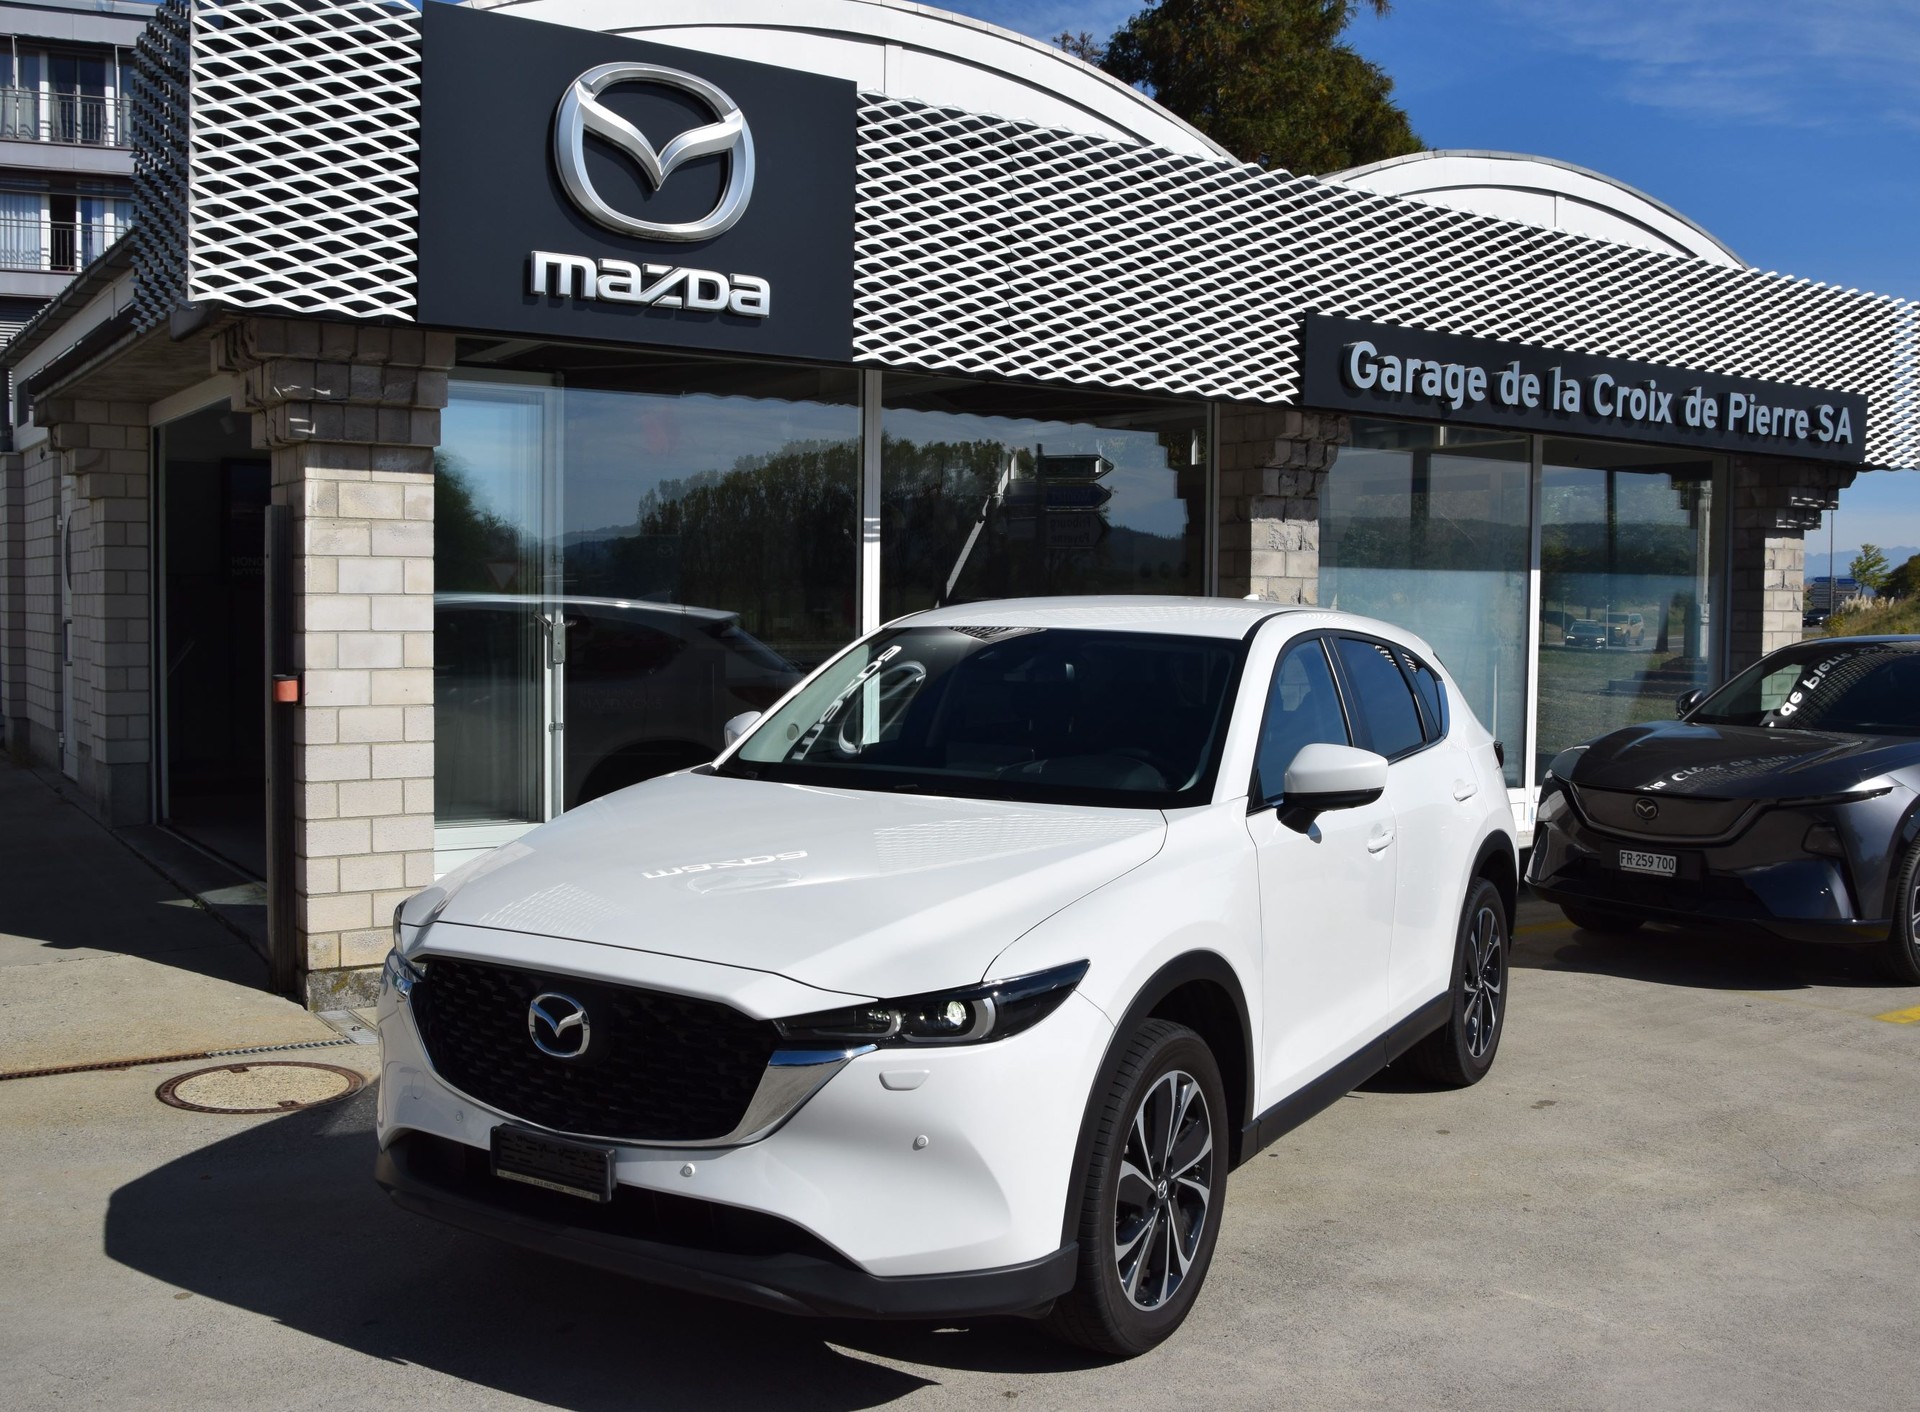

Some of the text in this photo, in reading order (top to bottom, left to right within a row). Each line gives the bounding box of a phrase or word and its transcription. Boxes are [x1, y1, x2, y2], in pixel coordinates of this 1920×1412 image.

[1345, 340, 1854, 444] Garage de la Croix de Pierre SA
[1656, 856, 1675, 871] 700
